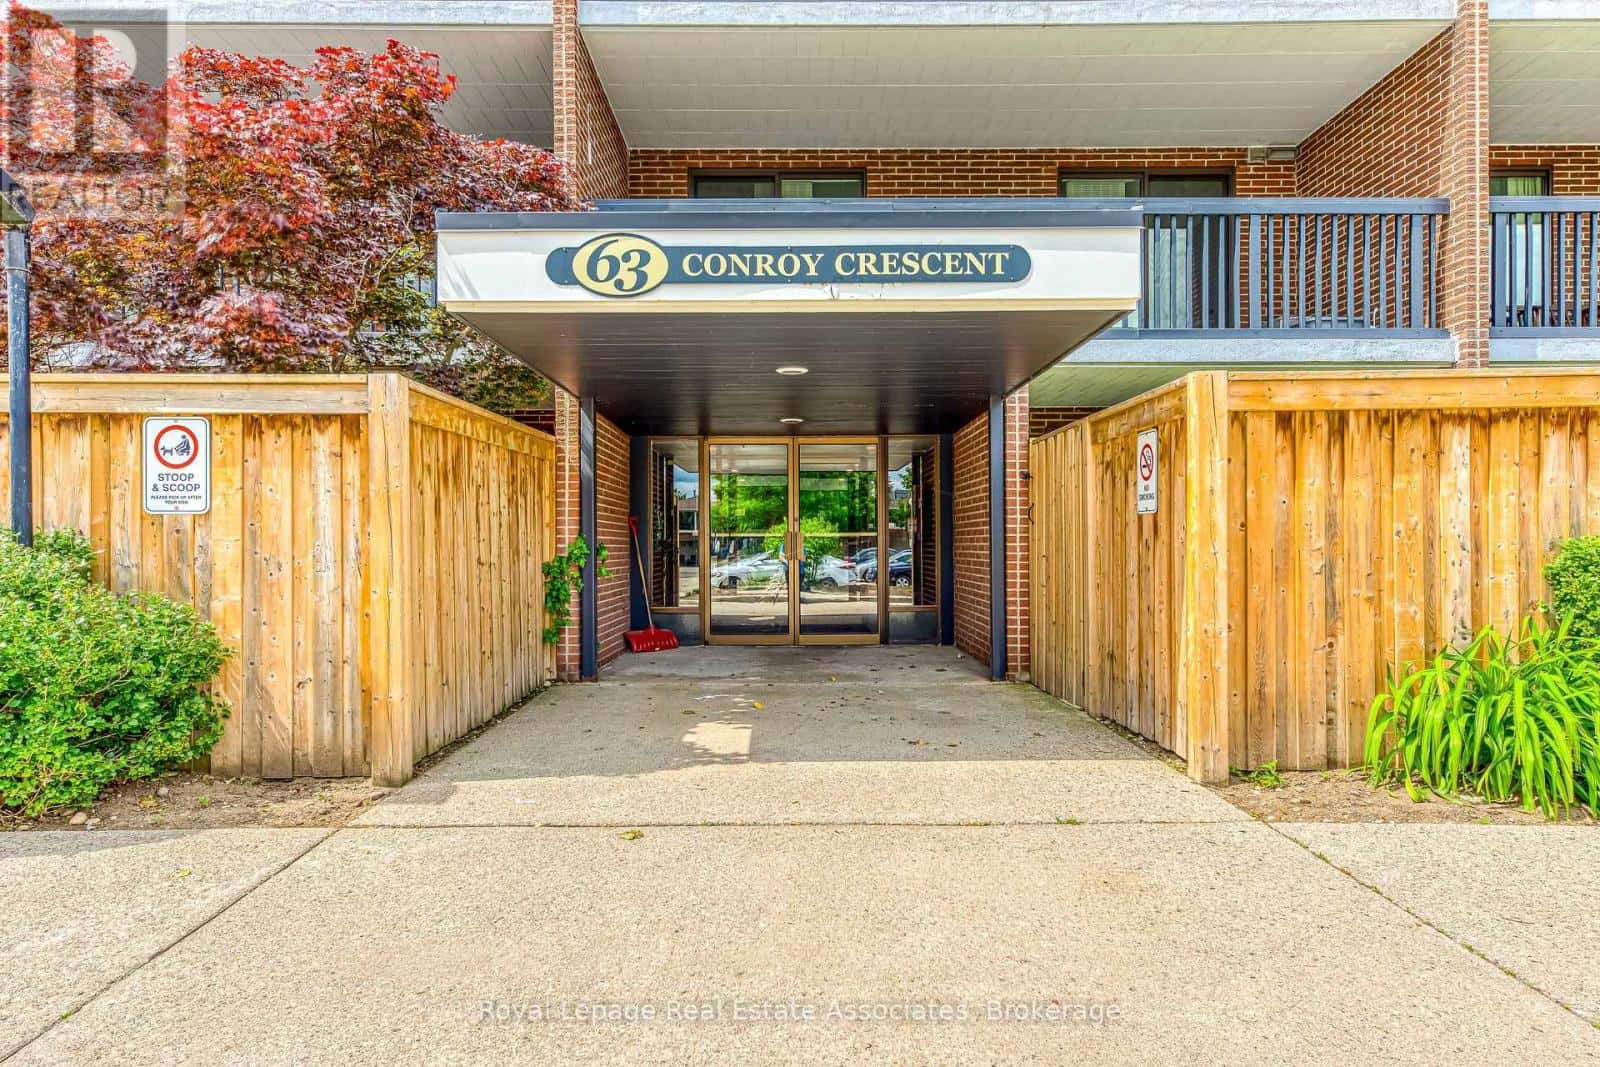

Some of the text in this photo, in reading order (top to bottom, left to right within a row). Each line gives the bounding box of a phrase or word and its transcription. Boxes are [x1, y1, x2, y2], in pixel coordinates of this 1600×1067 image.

[586, 238, 1011, 292] 63 CONROY CRESCENT
[158, 473, 194, 481] STOOP
[152, 483, 201, 491] & SCOOP
